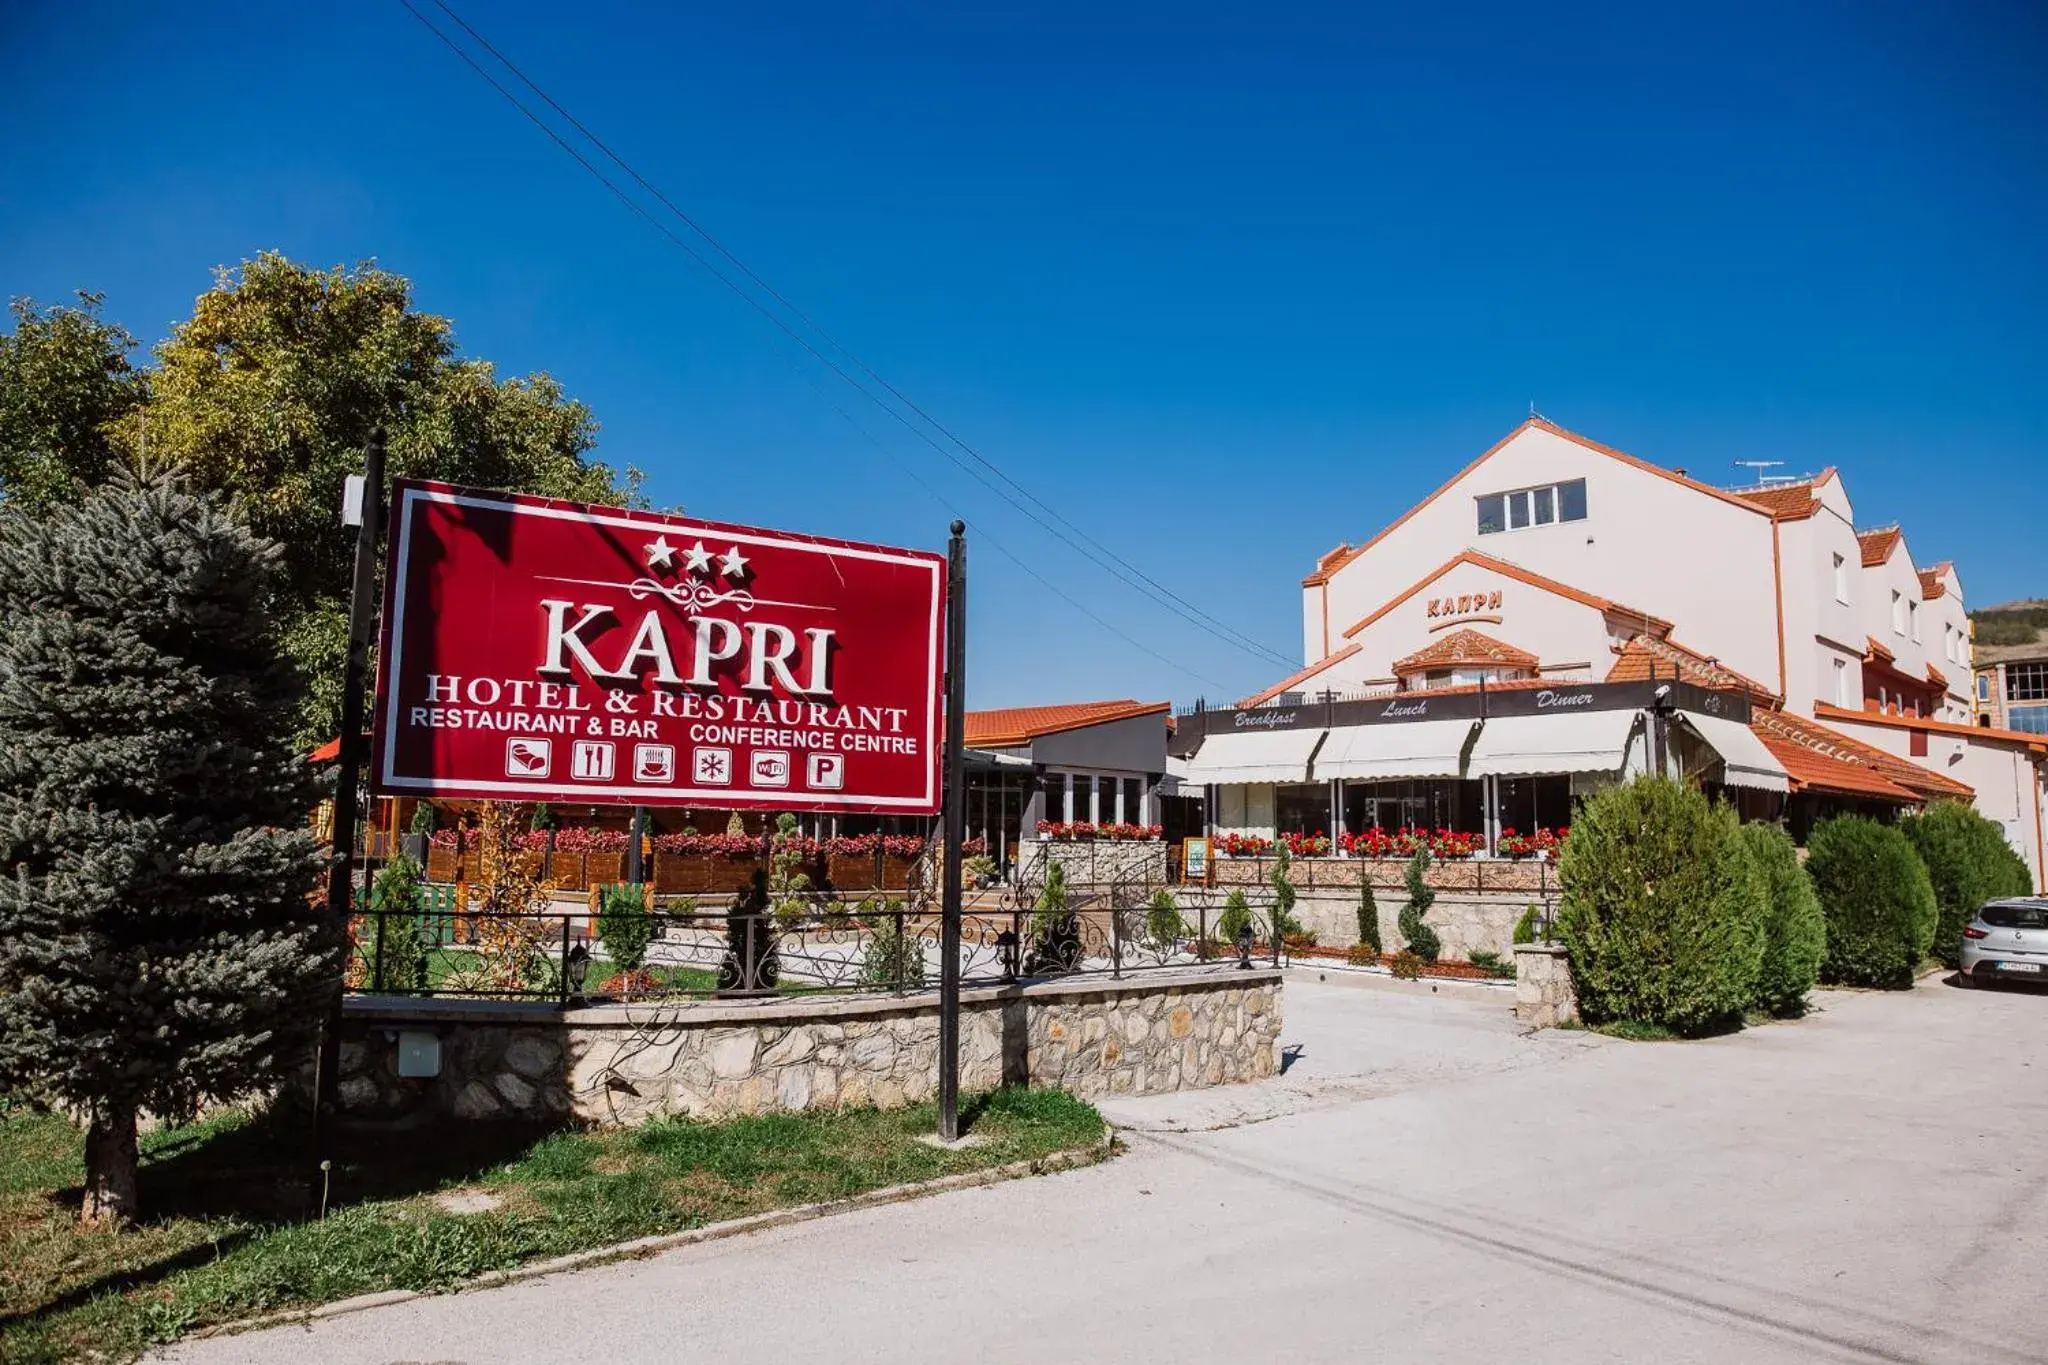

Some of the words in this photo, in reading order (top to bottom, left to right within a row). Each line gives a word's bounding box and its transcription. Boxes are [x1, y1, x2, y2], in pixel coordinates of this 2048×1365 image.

[536, 598, 836, 696] KAPRI
[425, 673, 591, 711] HOTEL
[604, 688, 639, 714] &
[651, 690, 908, 733] RESTAURANT
[1380, 700, 1427, 718] Lunch
[1536, 689, 1594, 708] Dinner
[410, 706, 581, 735] RESTAURANT
[586, 716, 604, 736] &
[610, 719, 660, 740] BAR
[1234, 710, 1297, 728] Breakfast
[689, 724, 836, 750] CONFERENCE
[840, 733, 918, 755] CENTRE
[815, 758, 836, 783] P
